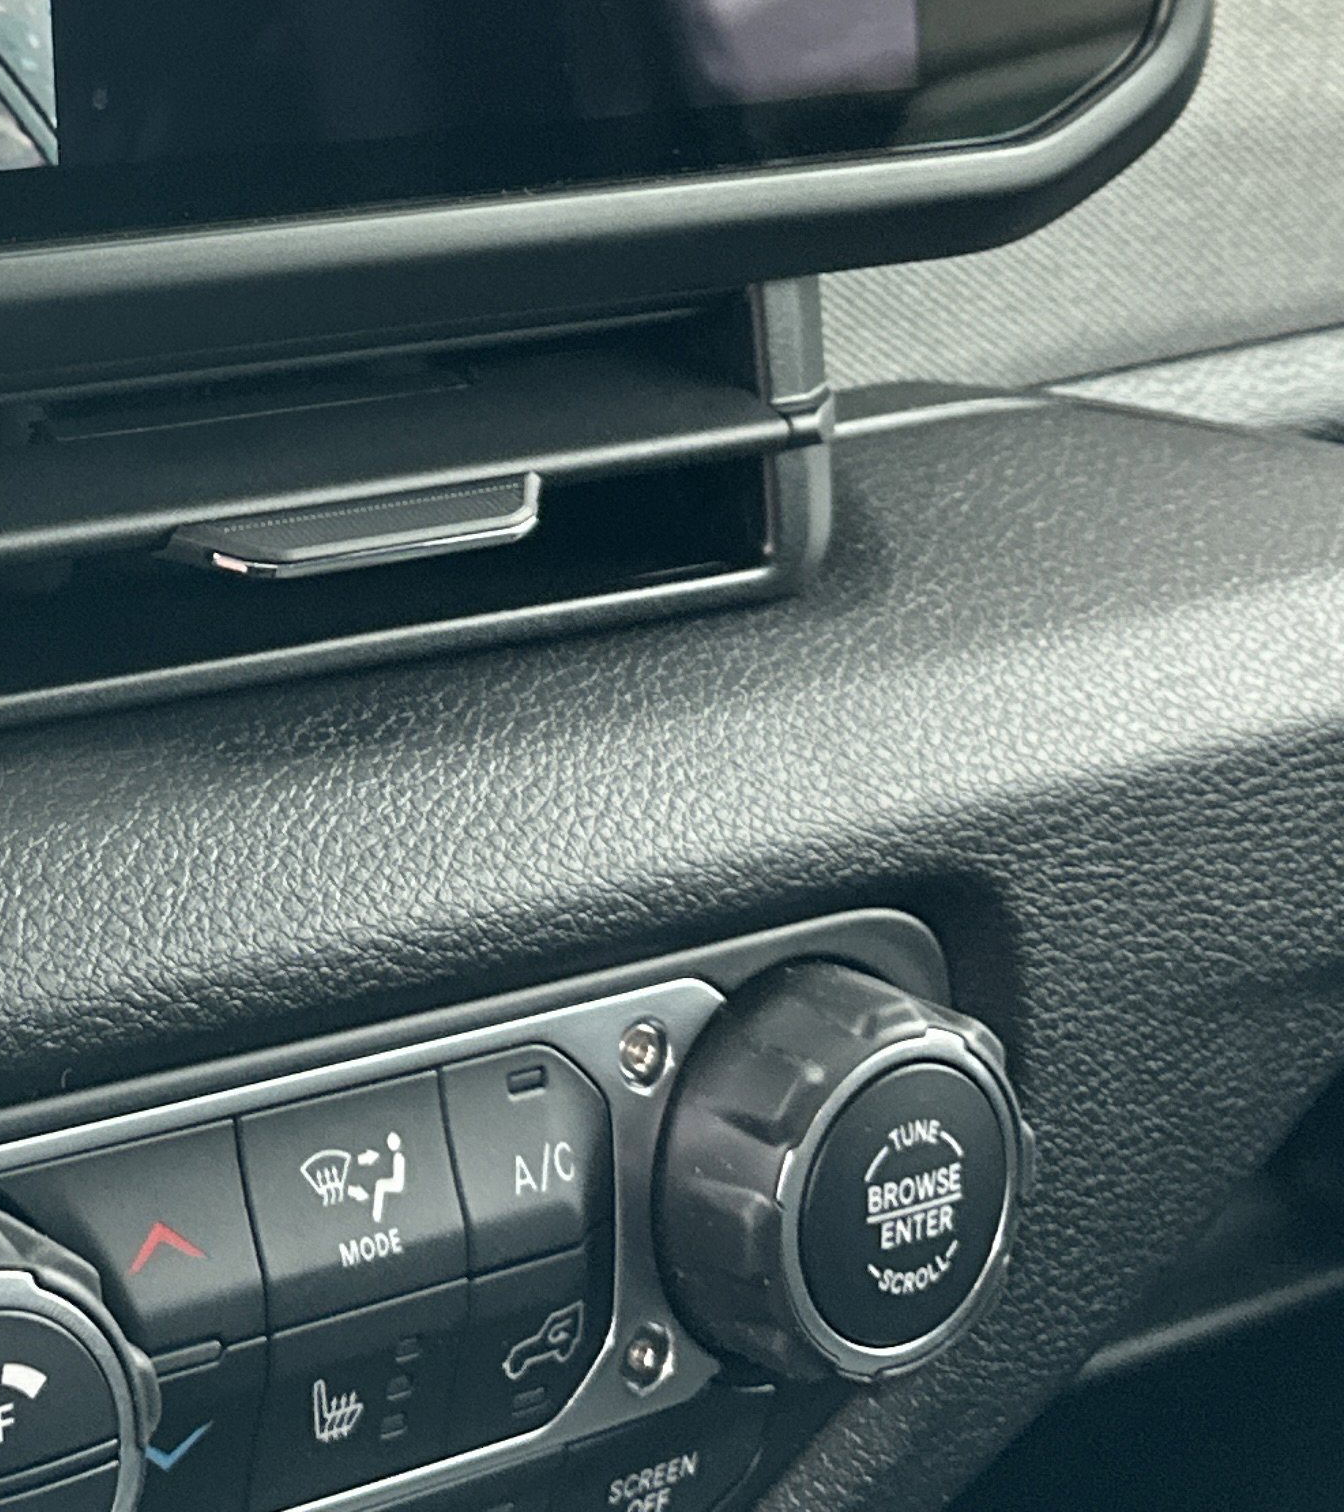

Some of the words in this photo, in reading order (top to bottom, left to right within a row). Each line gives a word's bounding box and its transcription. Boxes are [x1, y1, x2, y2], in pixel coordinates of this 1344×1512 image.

[888, 1119, 942, 1152] TUNE
[514, 1140, 577, 1195] A/C
[867, 1162, 963, 1215] BROWSE
[339, 1228, 404, 1267] MODE
[880, 1204, 954, 1251] ENTER
[878, 1255, 952, 1294] SCROLL
[608, 1451, 699, 1505] SCREEN
